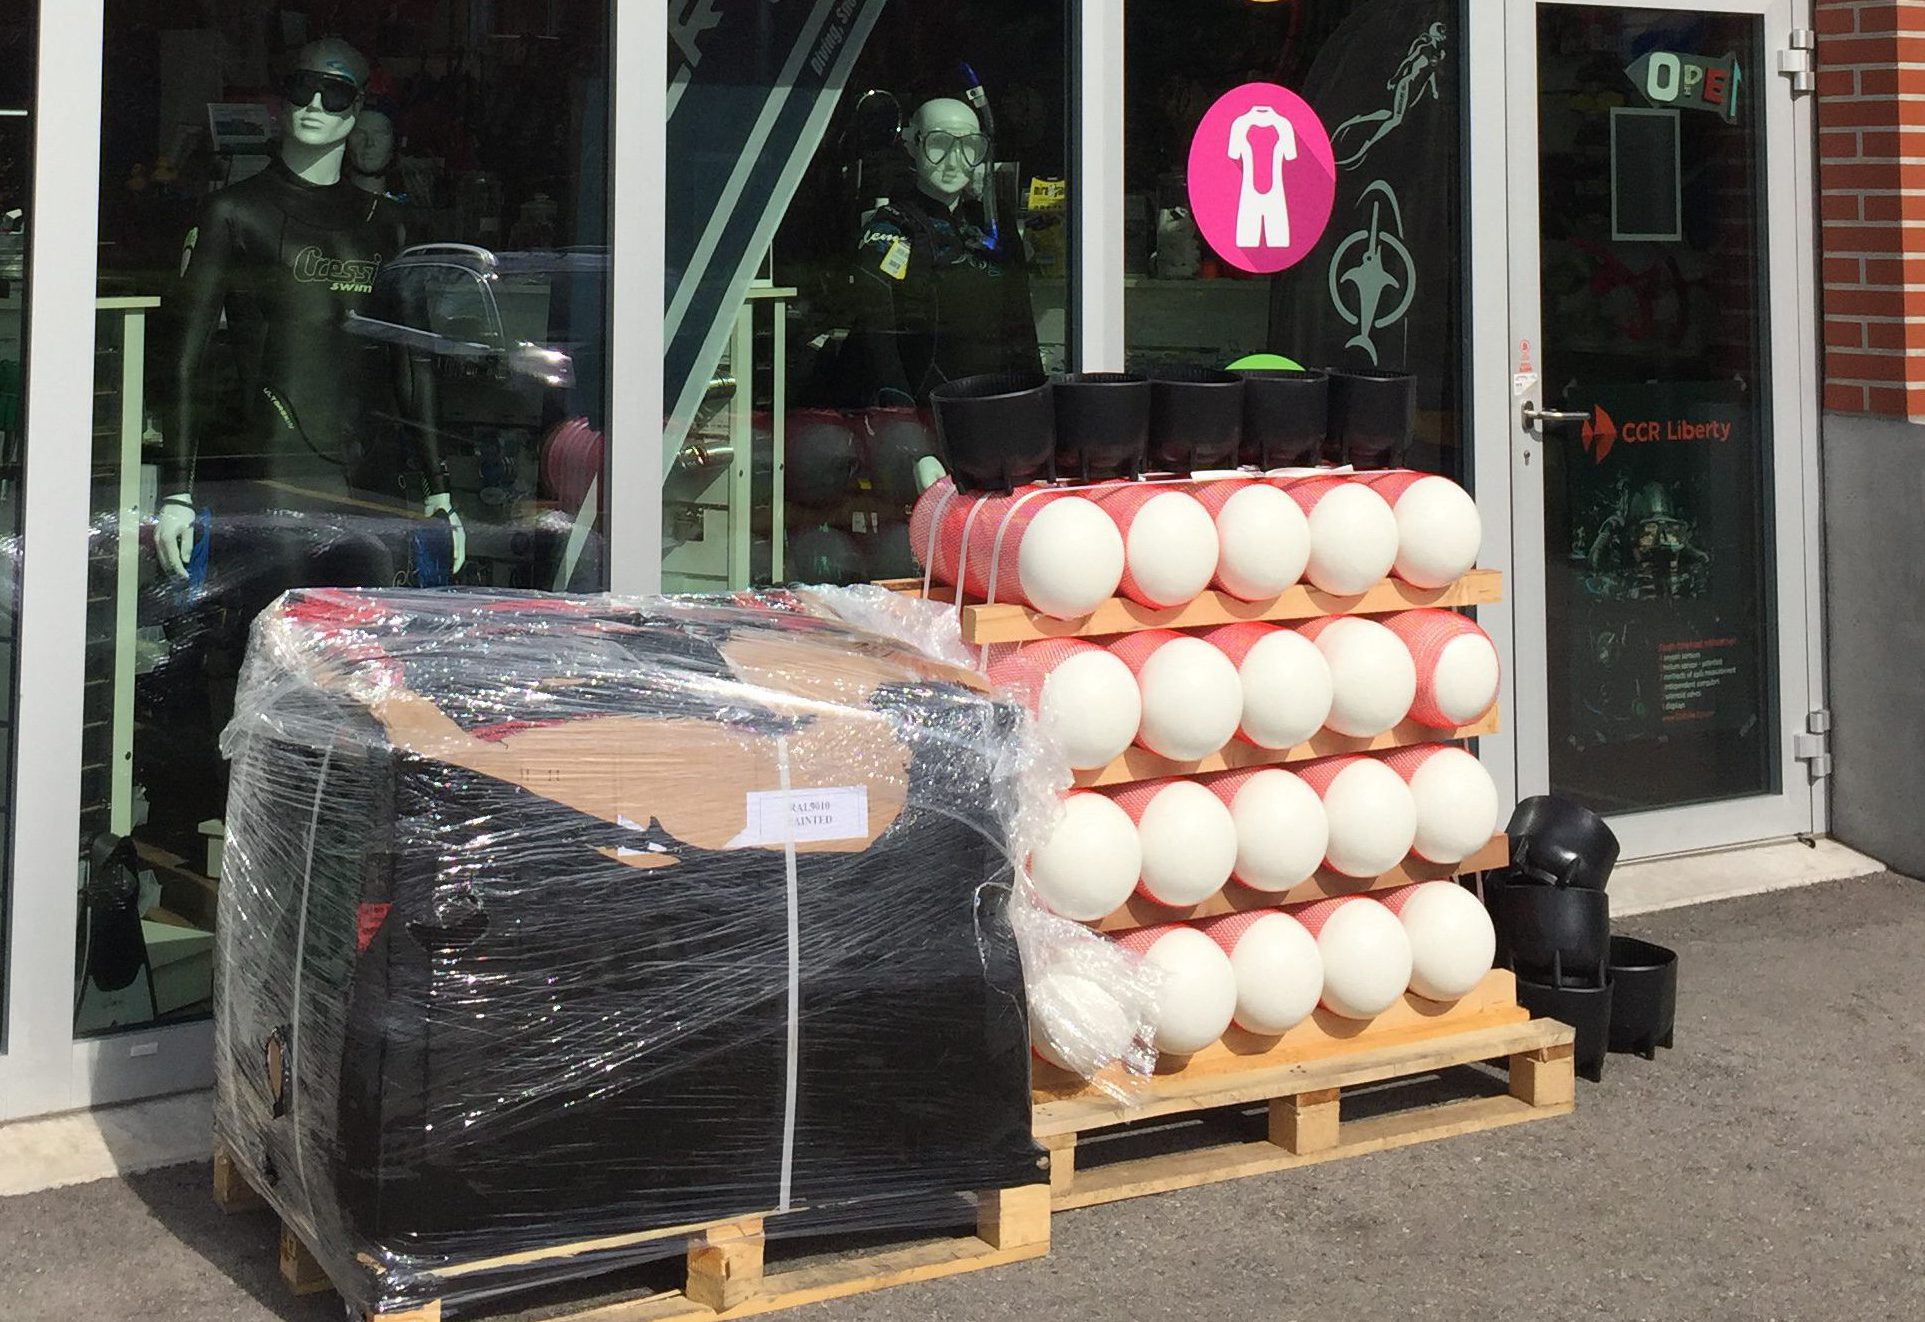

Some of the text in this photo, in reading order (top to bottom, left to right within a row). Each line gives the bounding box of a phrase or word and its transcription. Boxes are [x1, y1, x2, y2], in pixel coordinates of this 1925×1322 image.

[810, 23, 844, 77] Diving,
[293, 245, 382, 286] Cressi
[329, 282, 373, 293] swim
[1621, 419, 1732, 443] CCR Liberty
[795, 815, 833, 826] AINTED
